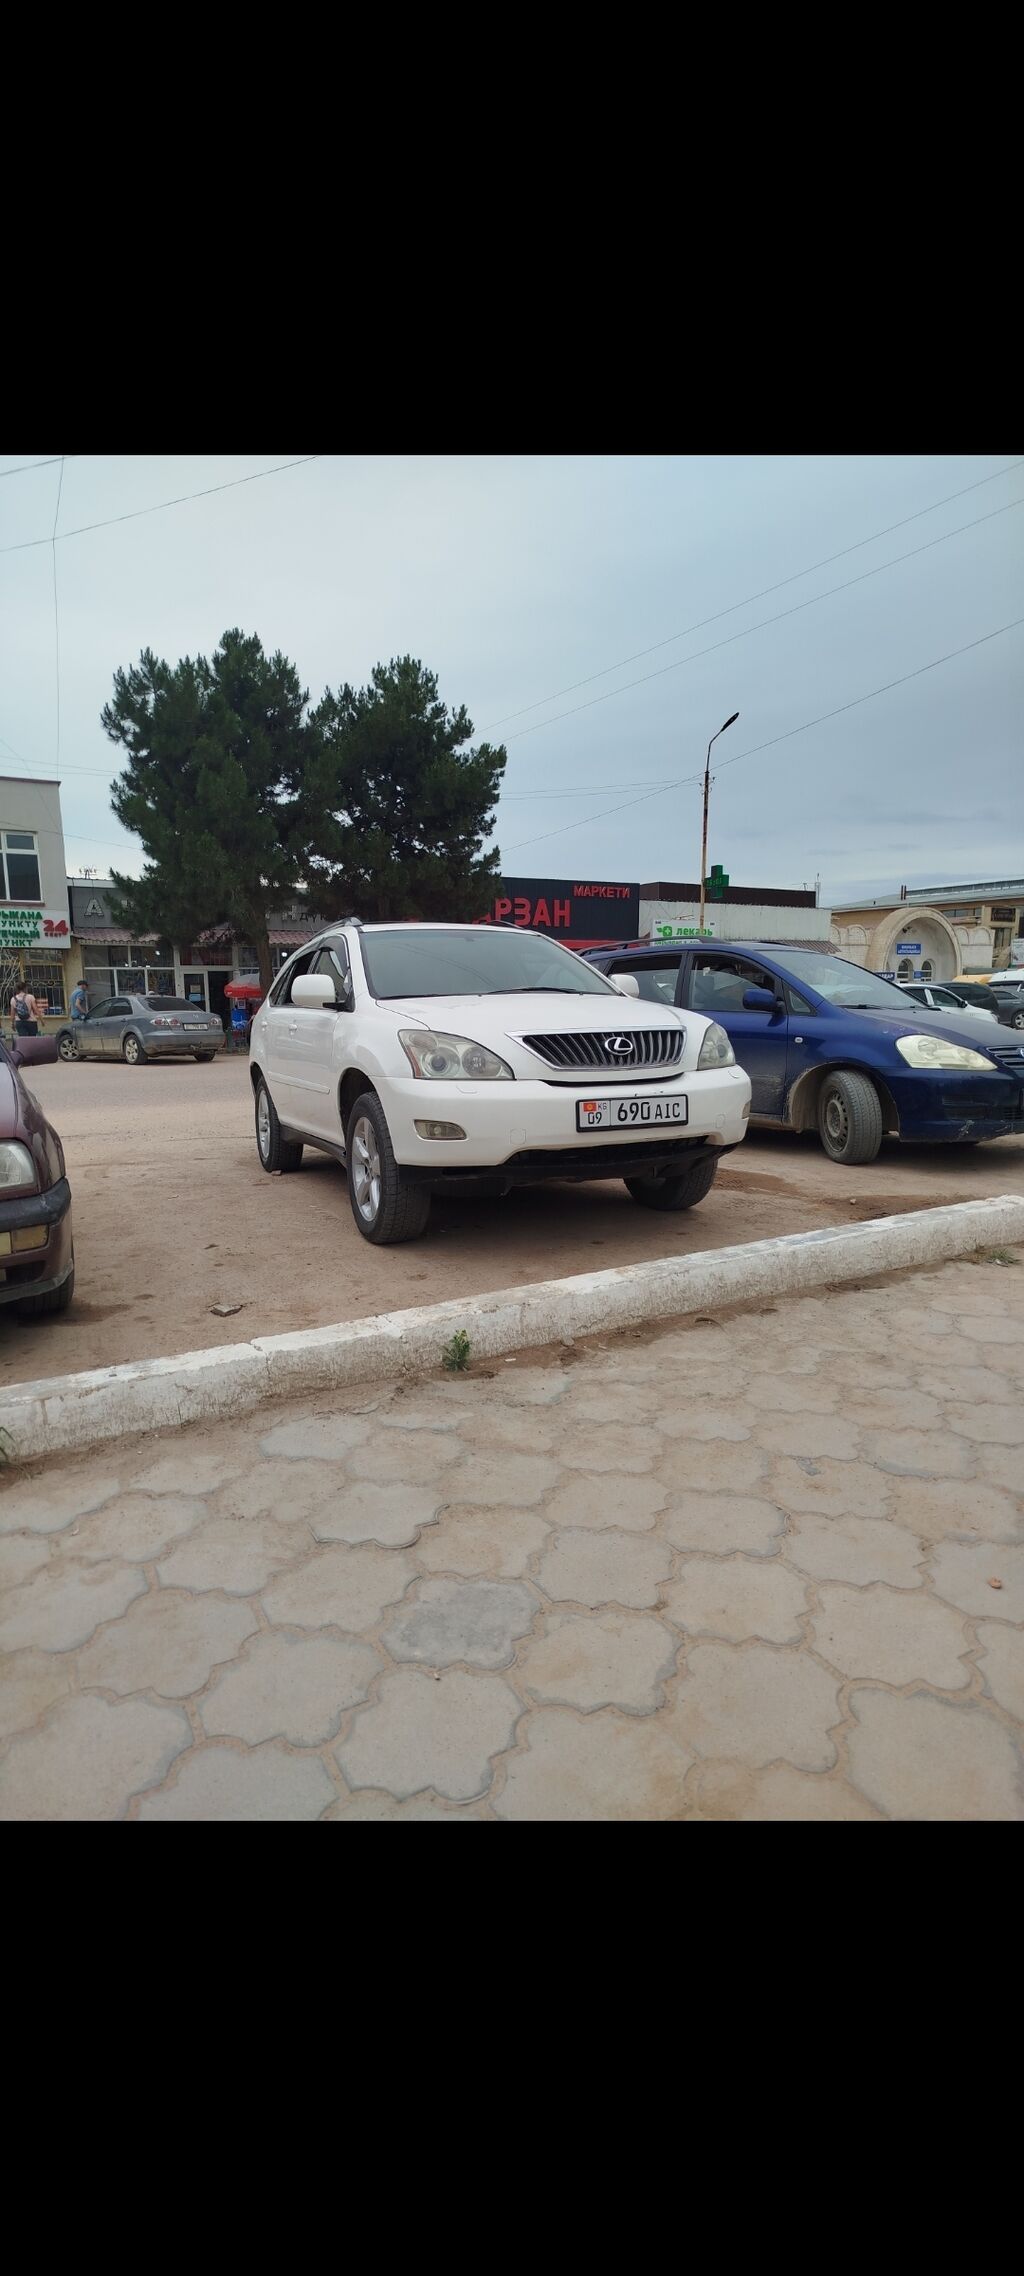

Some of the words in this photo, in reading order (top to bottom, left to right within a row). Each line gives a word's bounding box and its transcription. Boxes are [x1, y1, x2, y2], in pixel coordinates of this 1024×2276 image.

[573, 885, 631, 898] МАРКЕТИ
[0, 911, 43, 920] ЫКАНА
[0, 929, 40, 939] ЕЧНЫЙ
[43, 919, 69, 936] 24
[597, 1102, 608, 1110] KG
[617, 1101, 651, 1122] 690
[654, 1102, 681, 1120] AIC
[587, 1111, 603, 1125] 09
